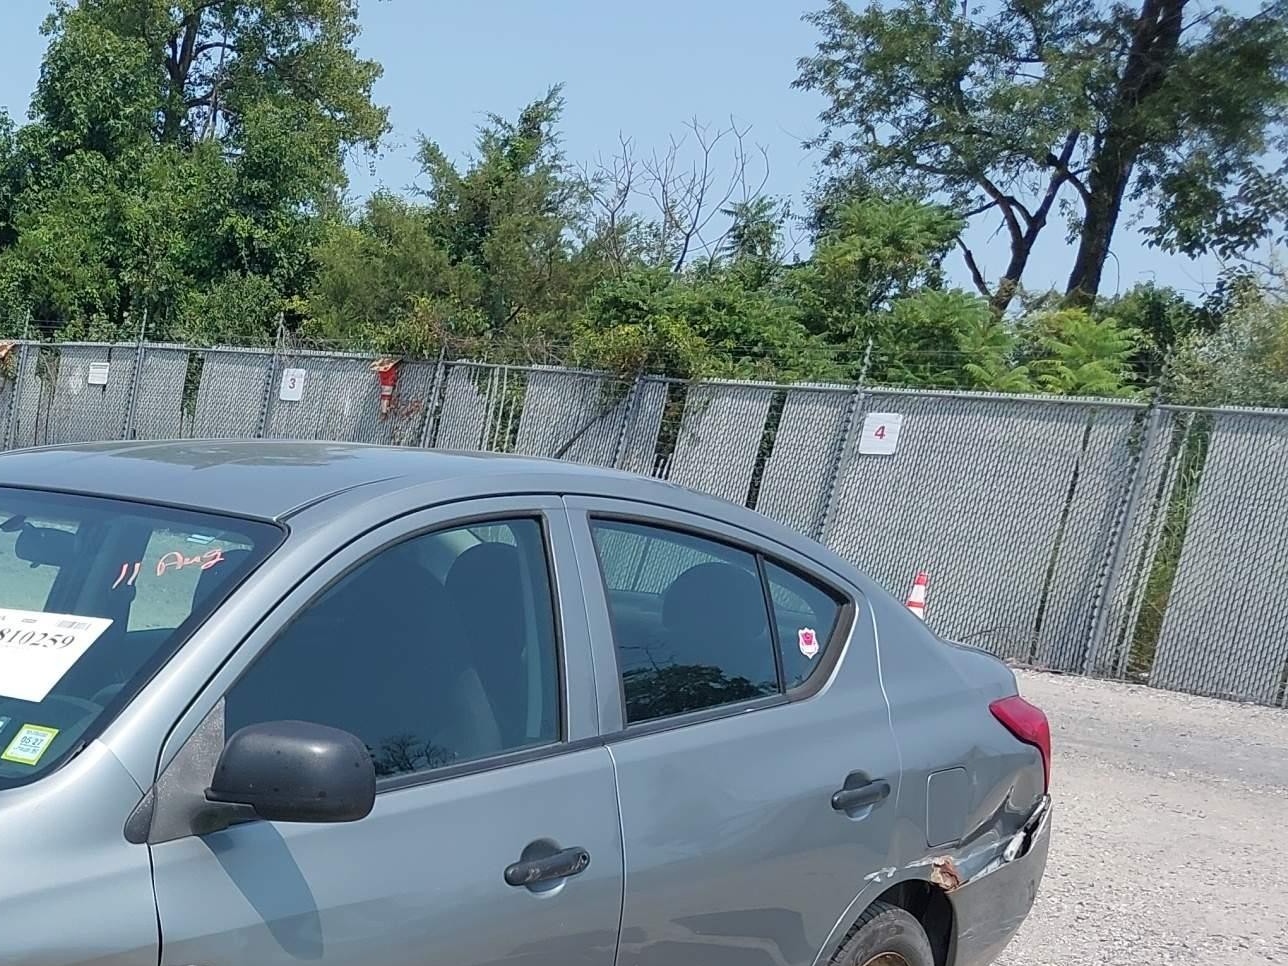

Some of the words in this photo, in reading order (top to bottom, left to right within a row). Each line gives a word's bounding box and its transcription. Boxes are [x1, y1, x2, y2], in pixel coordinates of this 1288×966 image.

[288, 377, 296, 390] 3
[874, 425, 886, 440] 4
[112, 562, 141, 590] 11
[156, 548, 225, 577] Aug
